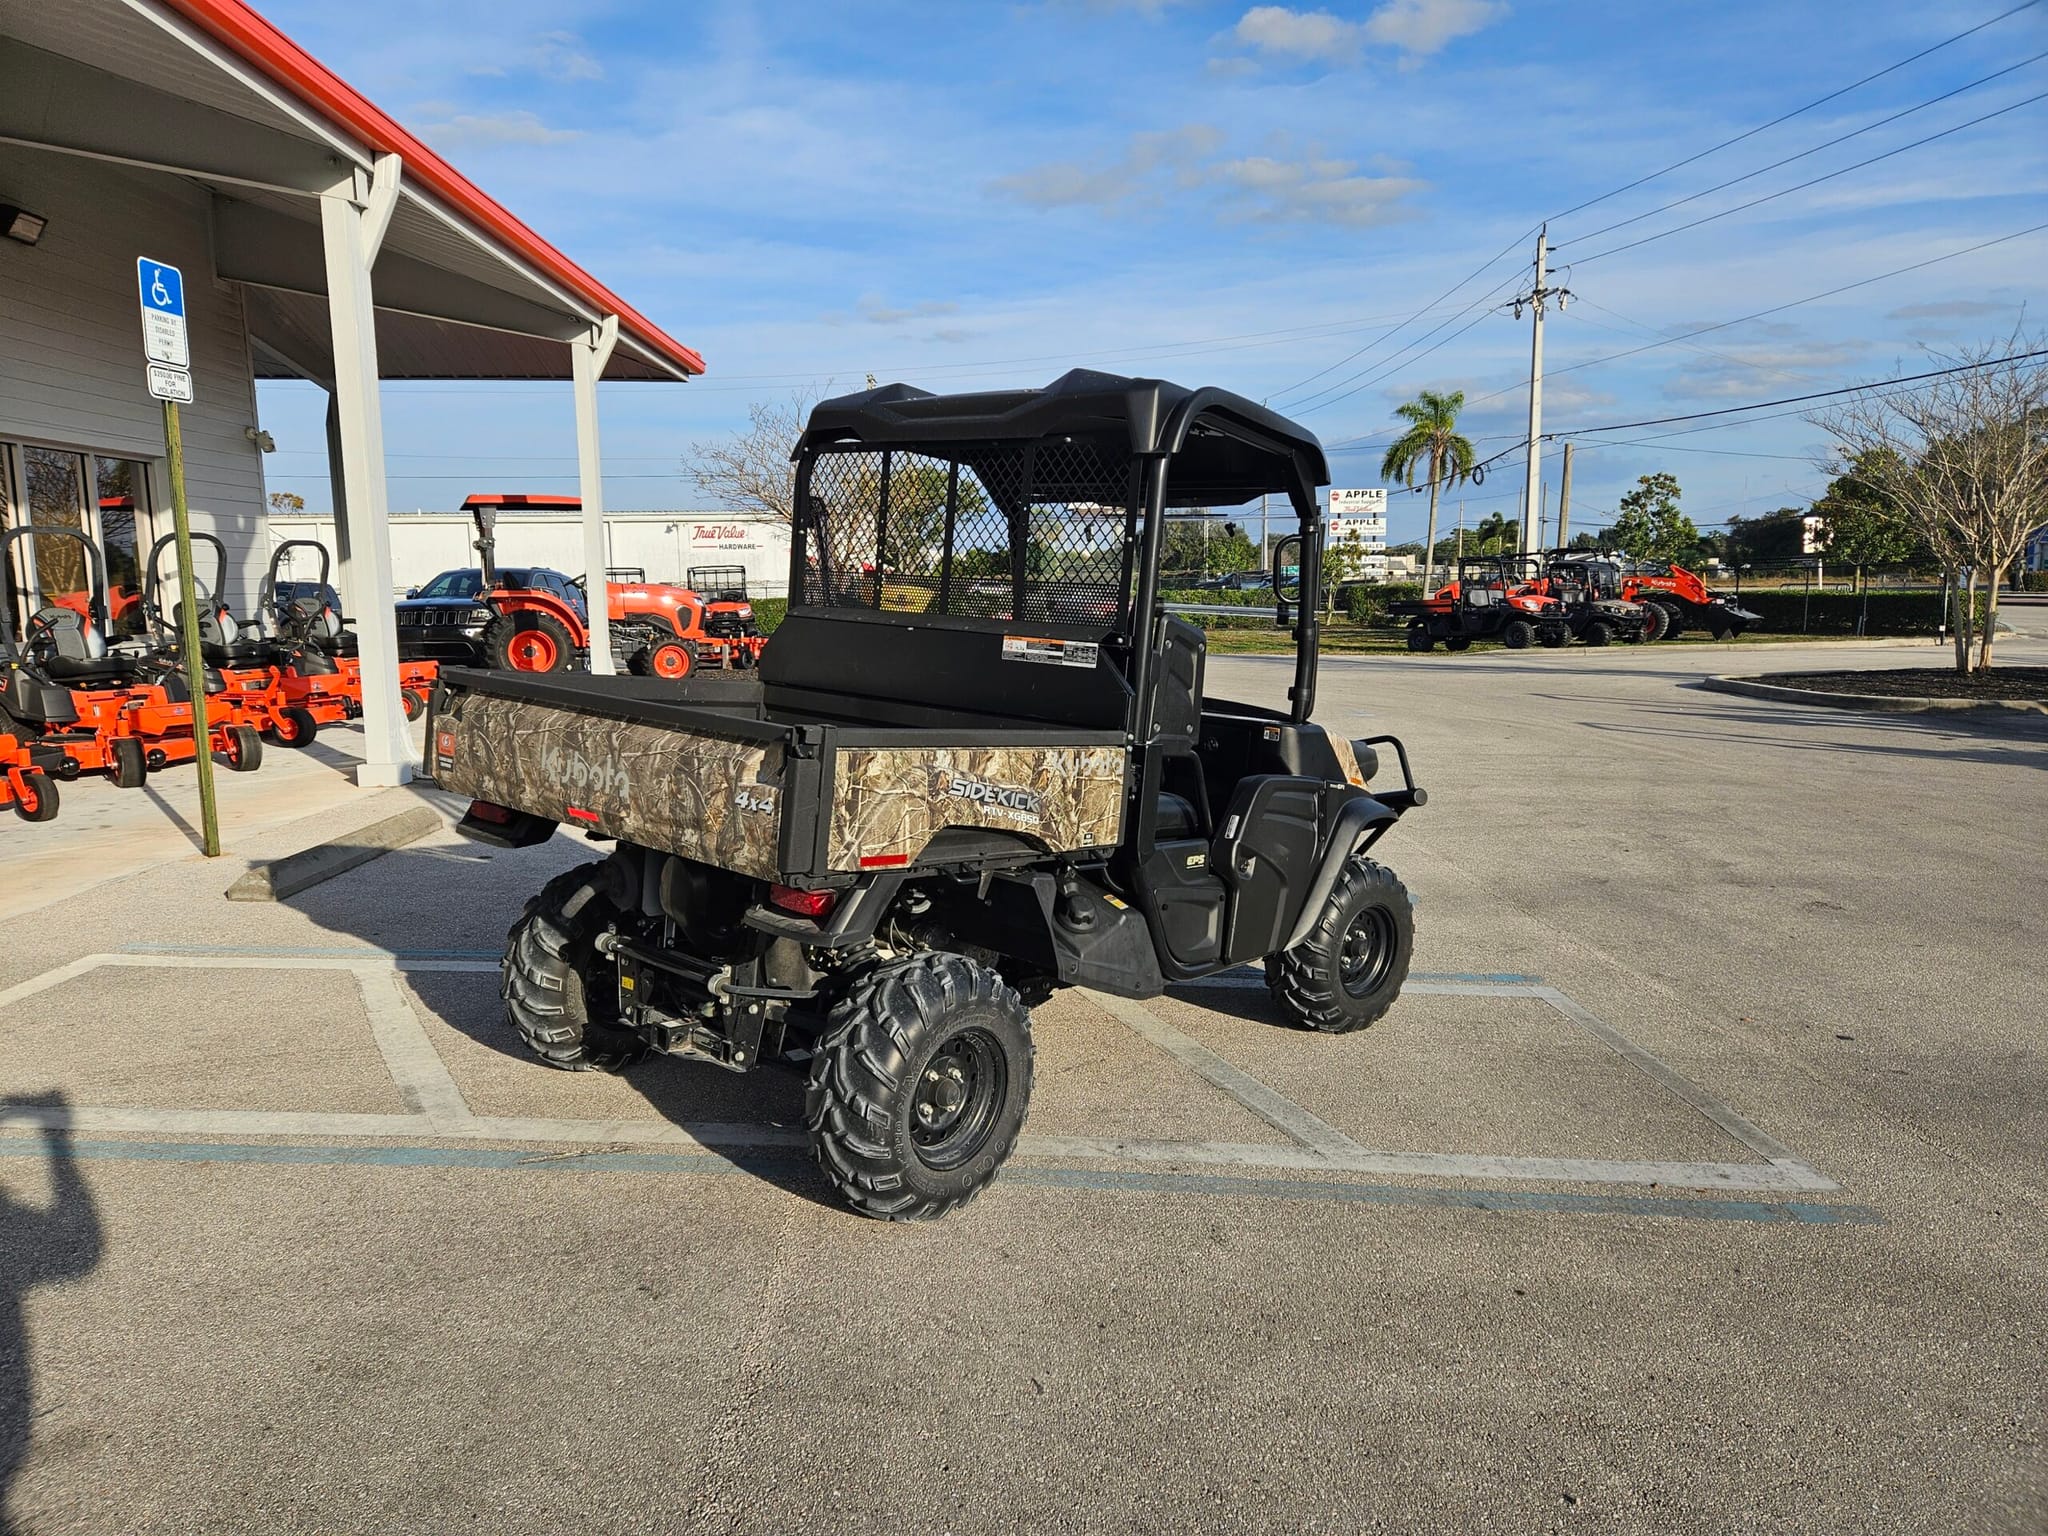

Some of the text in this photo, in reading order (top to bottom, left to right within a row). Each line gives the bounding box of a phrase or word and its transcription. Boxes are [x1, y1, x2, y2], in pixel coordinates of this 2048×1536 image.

[165, 380, 176, 388] FOR
[173, 373, 186, 382] FINE
[157, 386, 186, 397] VIOLATION
[1345, 490, 1383, 499] APPLE
[692, 525, 746, 541] True Value
[1651, 579, 1677, 588] Kubota
[1052, 749, 1125, 779] Kubota
[540, 745, 631, 804] Kubota
[734, 791, 775, 815] 4x4
[947, 779, 1041, 815] SIDEKICK
[983, 805, 1040, 825] RTV-XG850
[1186, 854, 1206, 866] EPS
